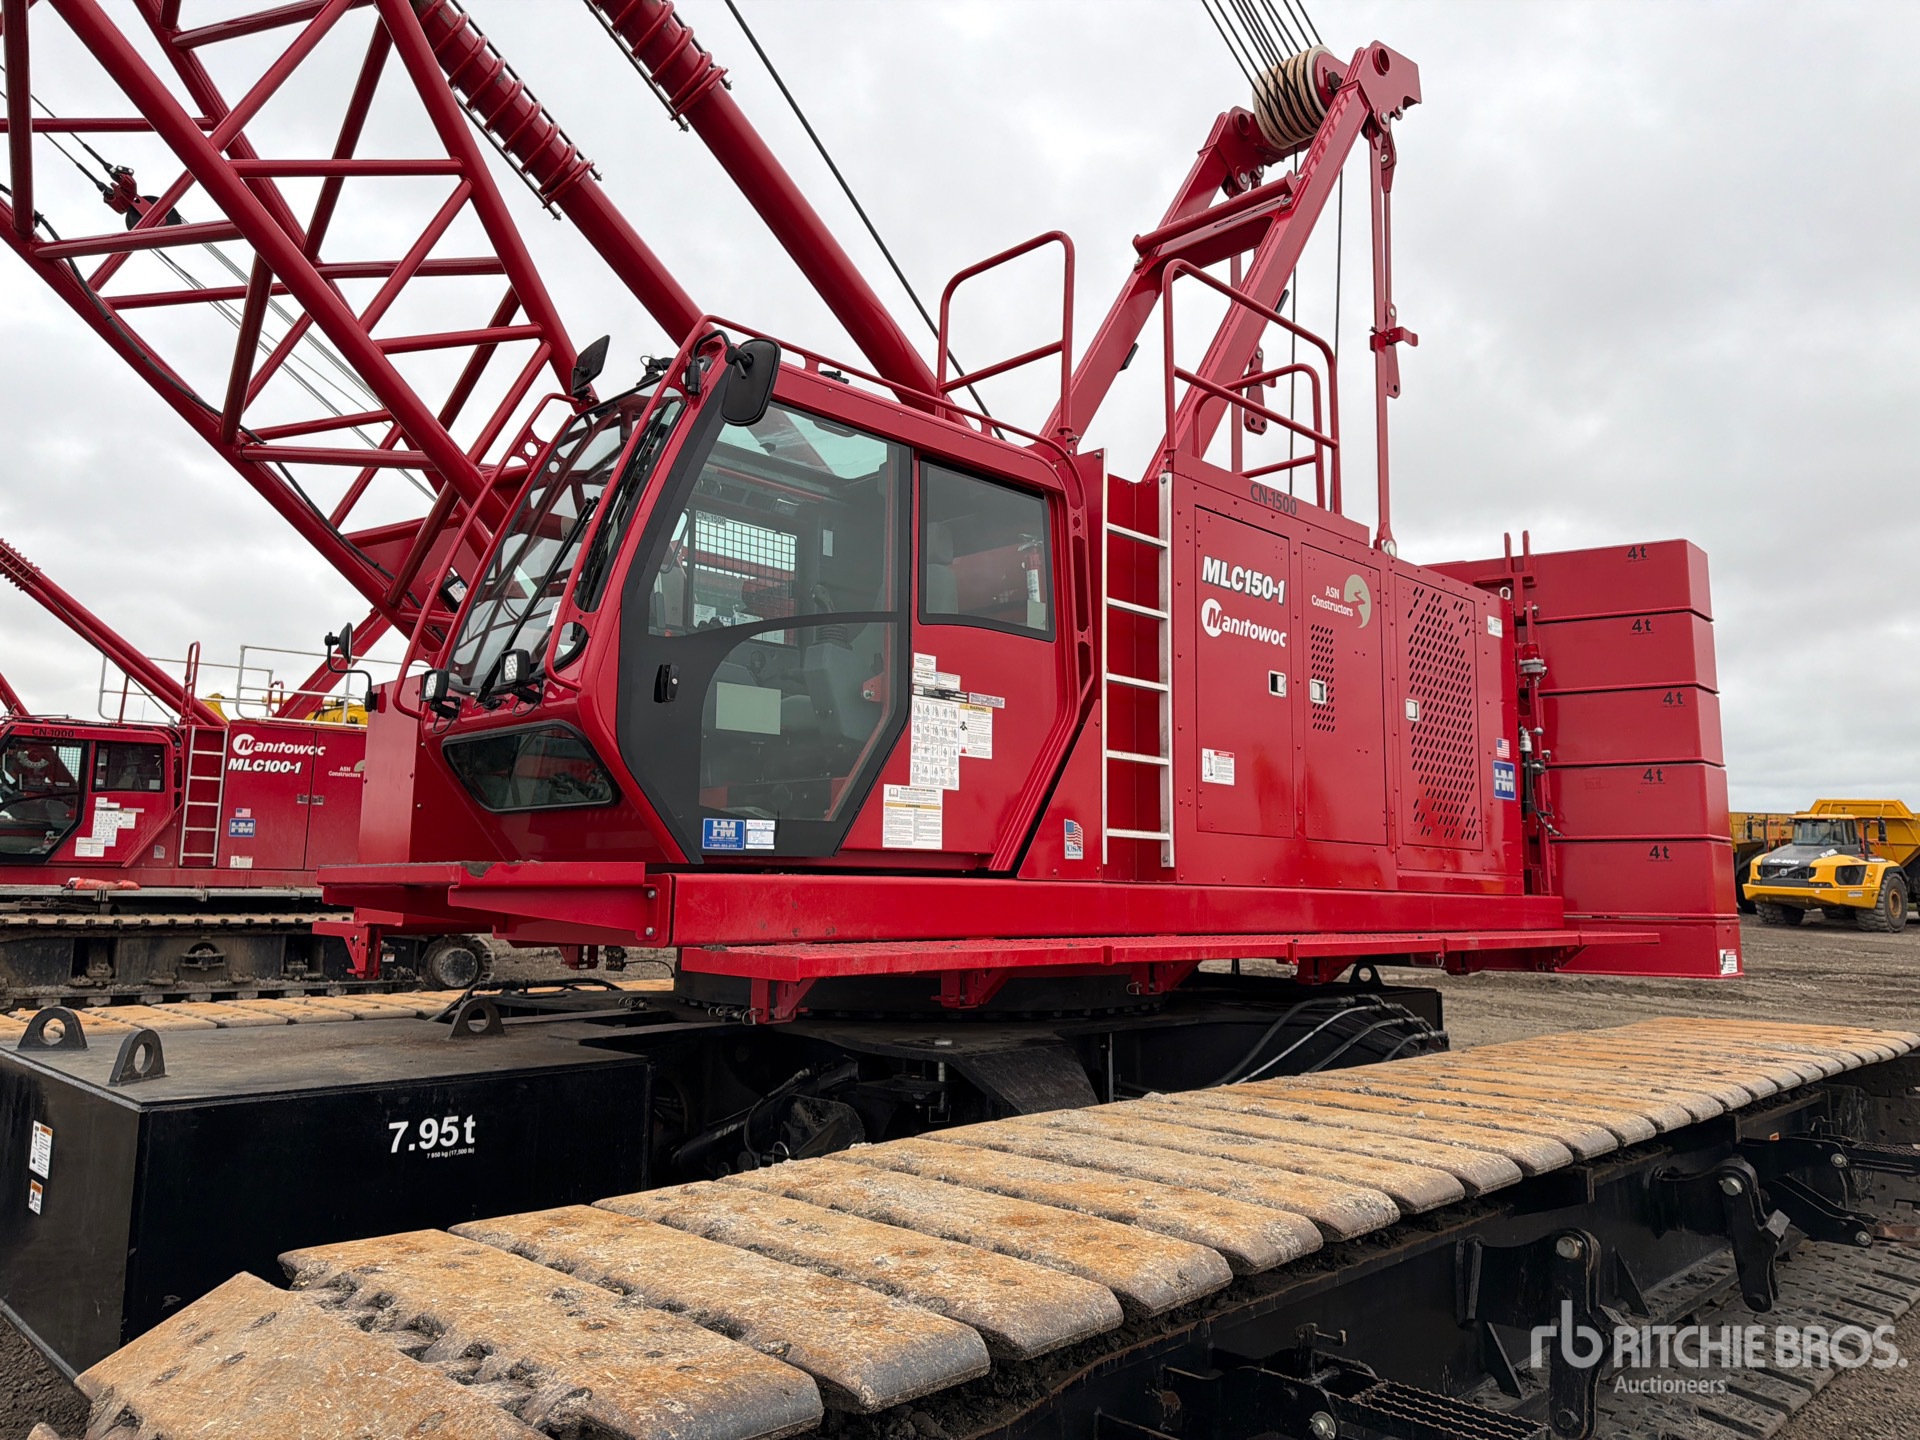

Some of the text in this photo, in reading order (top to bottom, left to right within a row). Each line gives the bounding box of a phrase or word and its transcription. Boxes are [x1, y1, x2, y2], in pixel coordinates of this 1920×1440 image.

[1251, 483, 1296, 515] CN-1500
[696, 511, 726, 525] CN-1500
[1202, 555, 1285, 604] MLC150-1
[1325, 585, 1340, 600] ASN
[1311, 594, 1354, 617] Constructors
[1201, 598, 1287, 647] Manitowoc
[31, 728, 75, 738] CN-1000
[232, 733, 326, 756] Manitowoc
[227, 758, 302, 774] MLC100-1
[328, 770, 361, 778] Constructors
